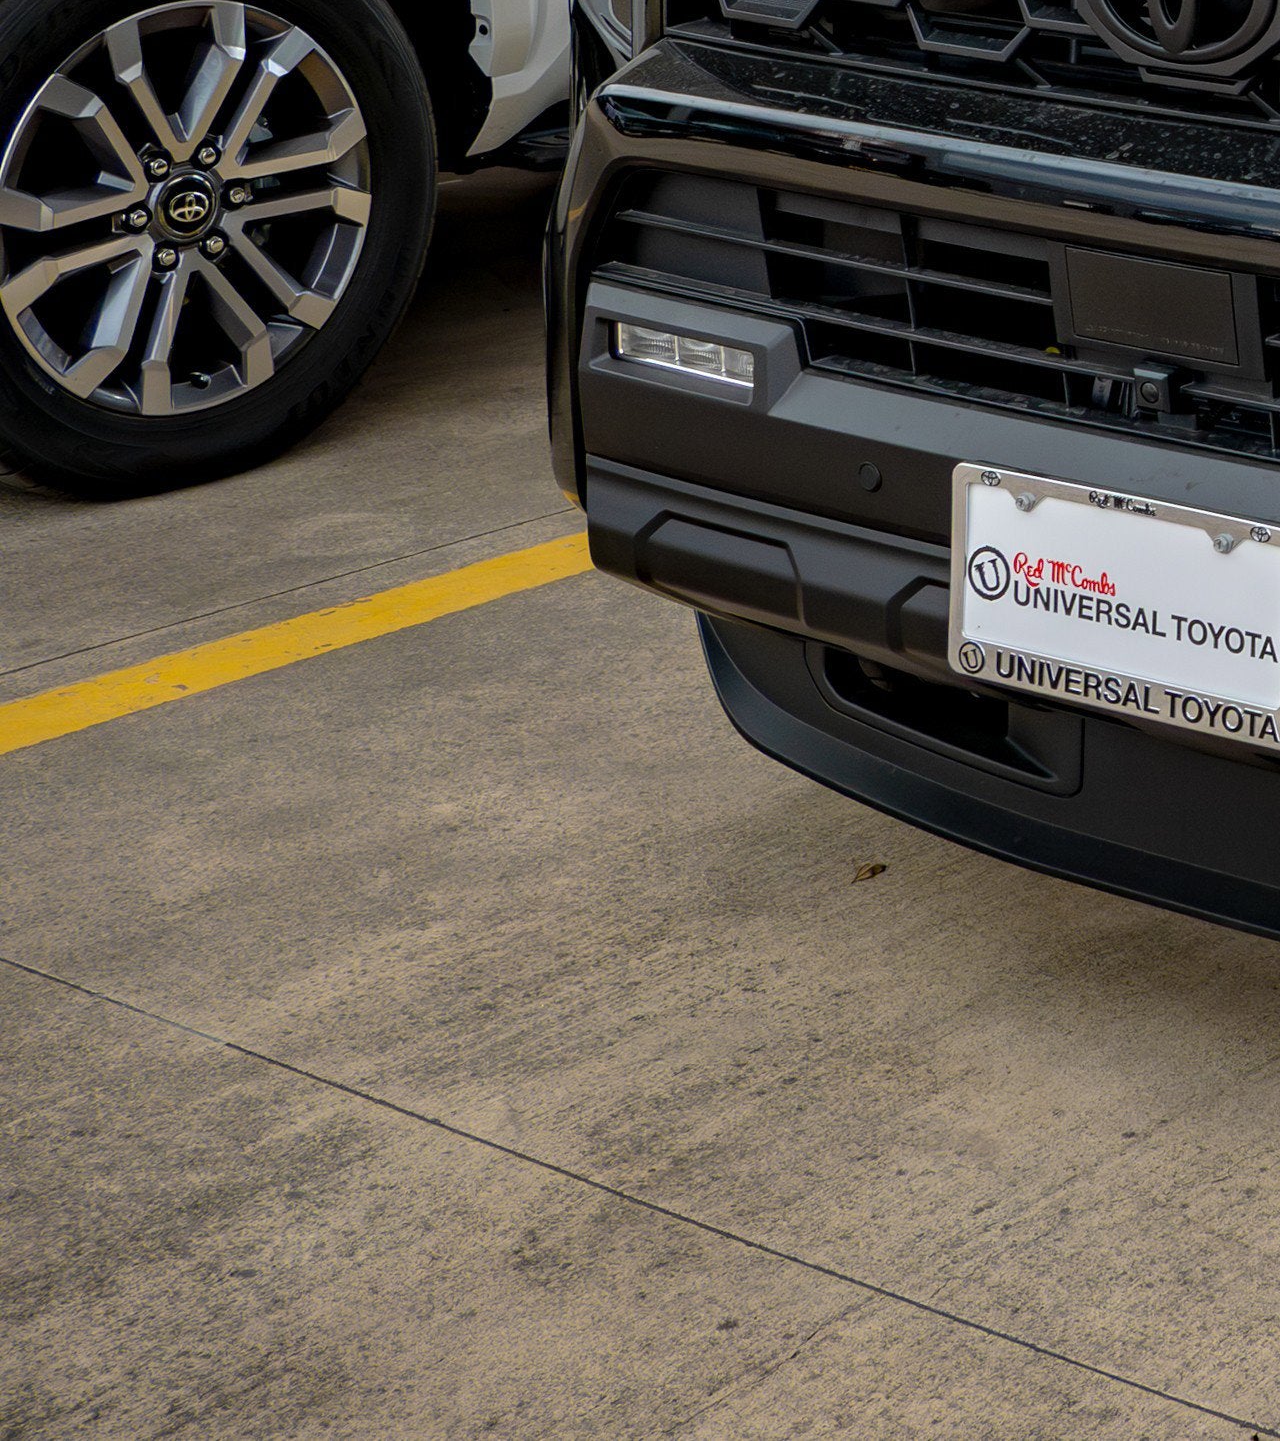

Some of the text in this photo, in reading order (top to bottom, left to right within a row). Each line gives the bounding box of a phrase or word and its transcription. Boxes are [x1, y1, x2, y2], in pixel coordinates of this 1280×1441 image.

[1013, 551, 1117, 597] Red McCombs
[1013, 580, 1279, 663] UNIVERSAL TOYOTA
[996, 650, 1280, 743] UNIVERSAL TOYOTA
